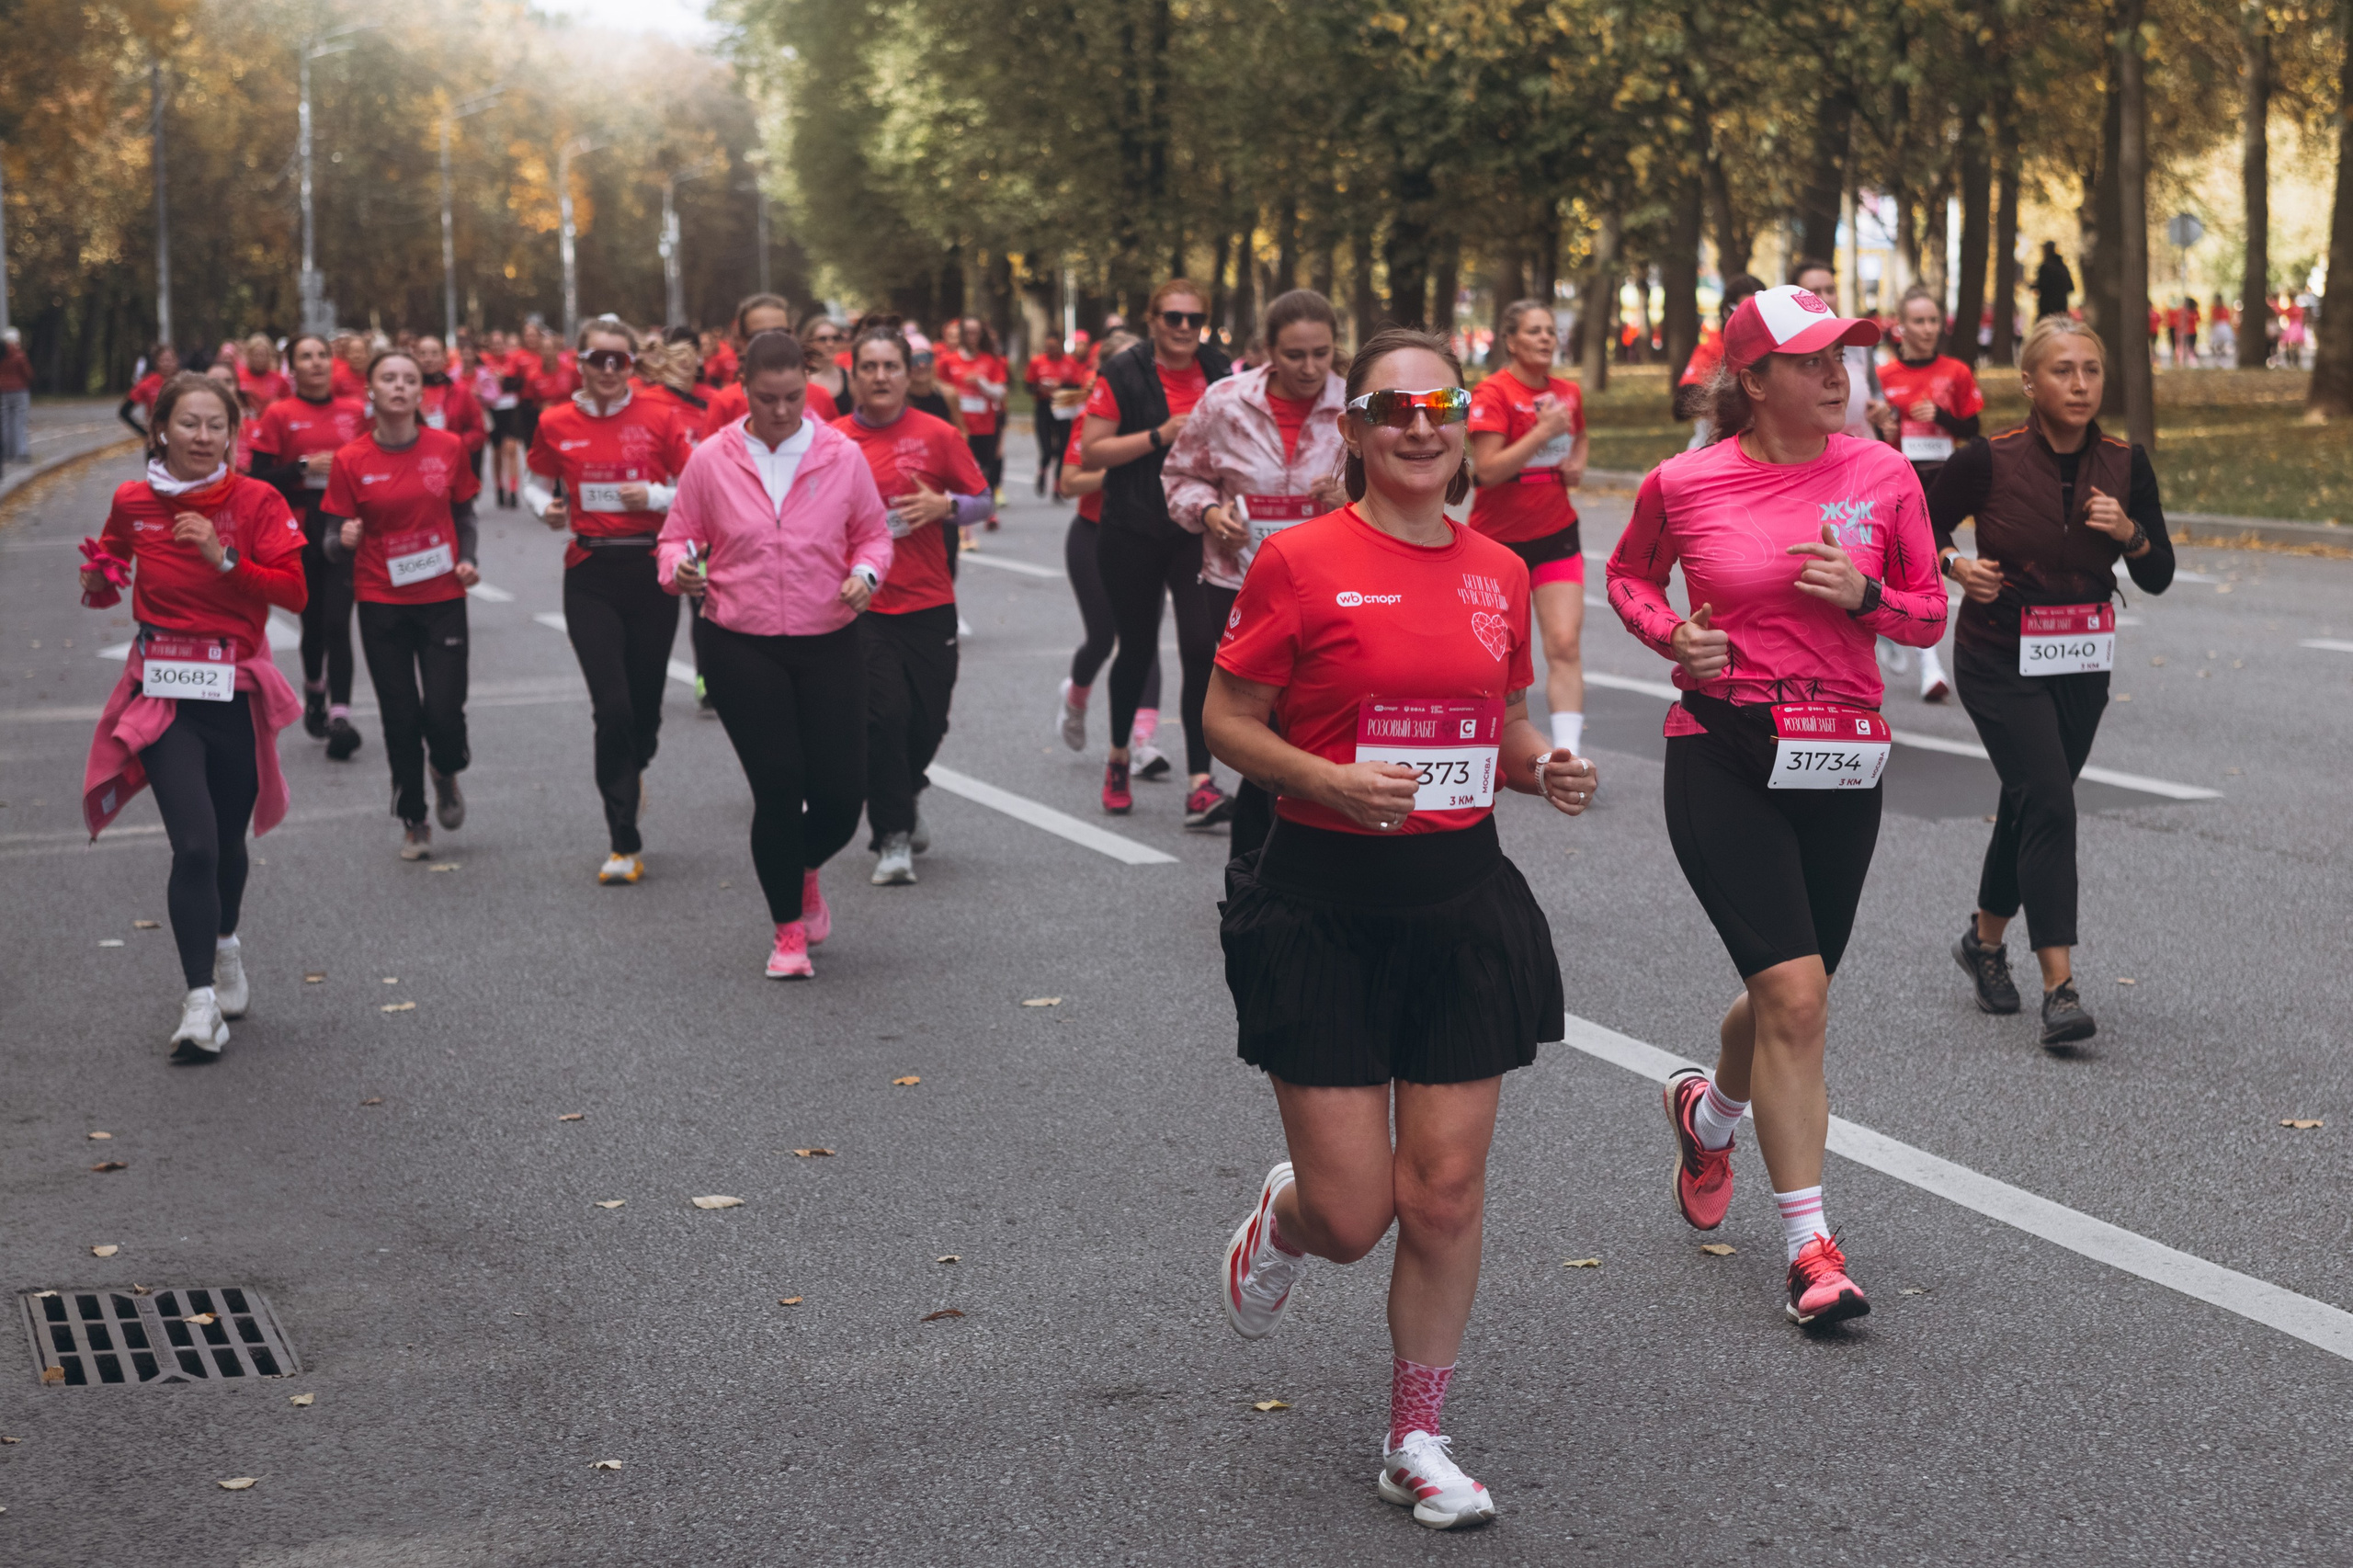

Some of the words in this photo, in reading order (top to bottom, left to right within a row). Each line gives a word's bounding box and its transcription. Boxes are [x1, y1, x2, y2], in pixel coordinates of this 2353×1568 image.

[1819, 495, 1875, 528] ЖУК
[1364, 595, 1402, 606] спорт
[2029, 642, 2096, 660] 30140
[150, 667, 218, 686] 30682
[1367, 718, 1411, 737] РОЗОВЫЙ
[1411, 720, 1438, 738] ЗАБЕГ
[1783, 716, 1817, 732] РОЗОВЫЙ
[1817, 718, 1836, 733] ЗАБЕГ
[1786, 751, 1861, 771] 31734
[1369, 759, 1470, 786] 373
[1483, 756, 1492, 793] МОСКВА
[1449, 796, 1456, 806] 3
